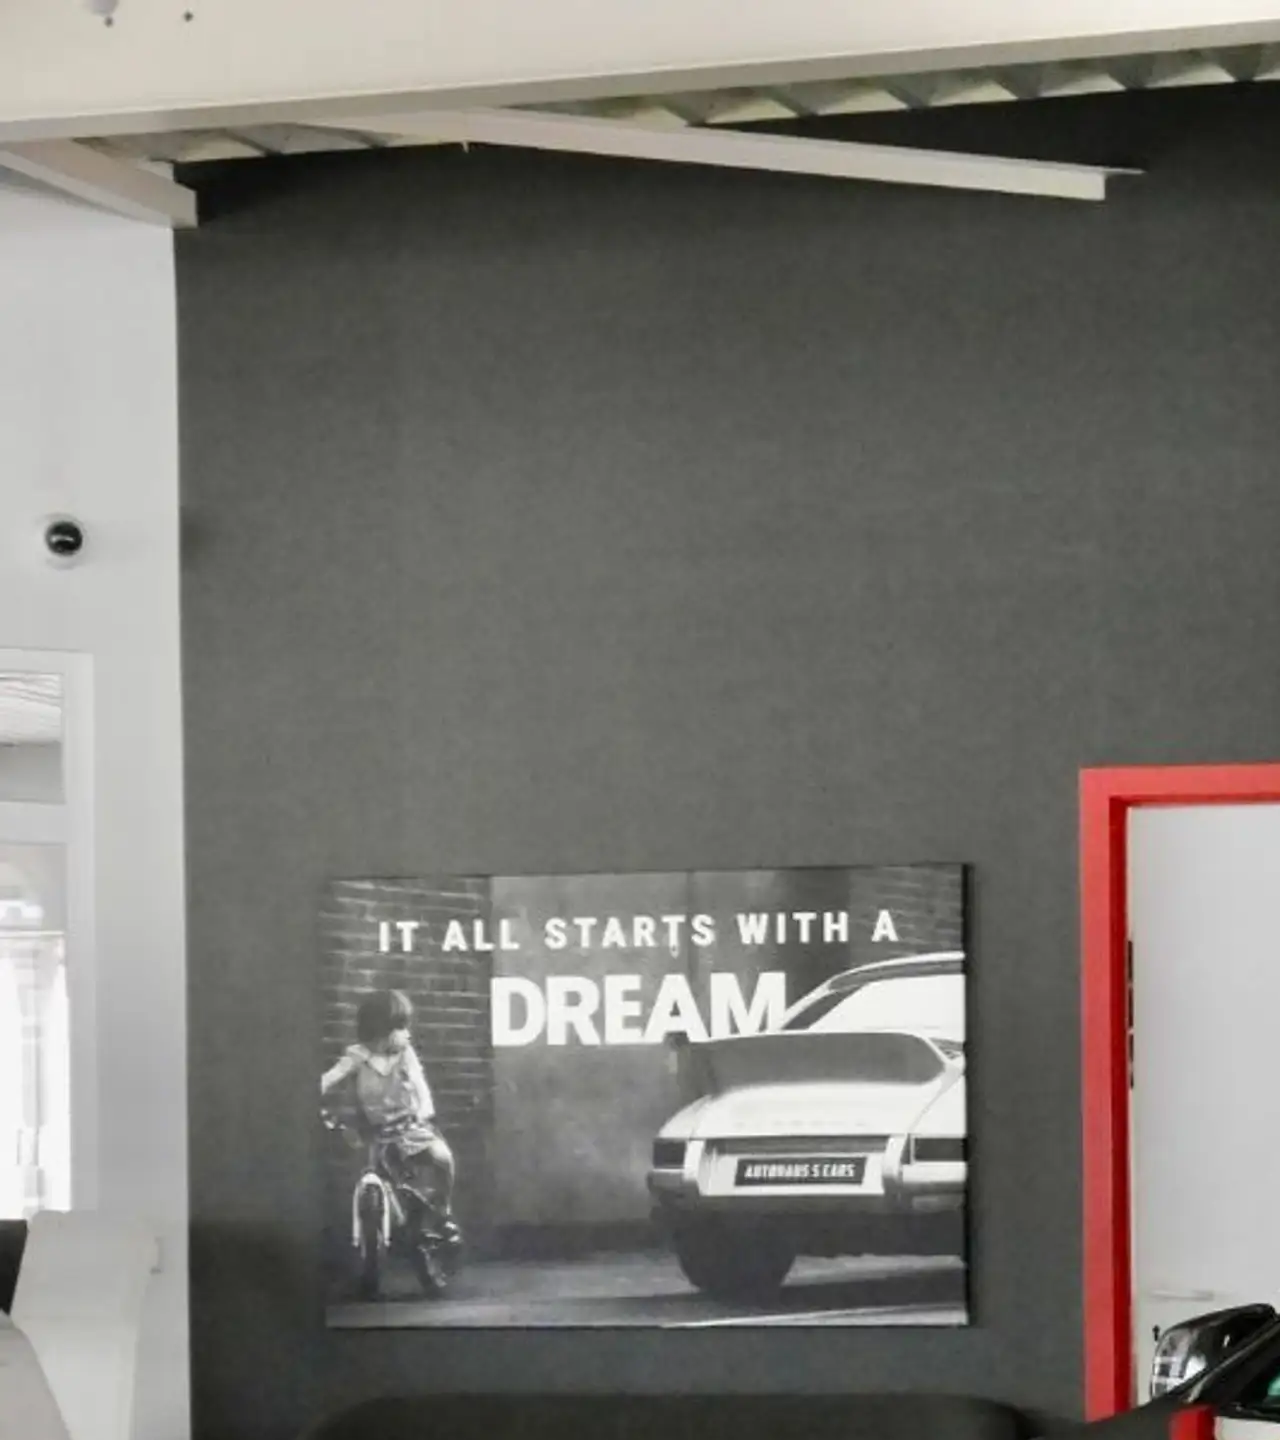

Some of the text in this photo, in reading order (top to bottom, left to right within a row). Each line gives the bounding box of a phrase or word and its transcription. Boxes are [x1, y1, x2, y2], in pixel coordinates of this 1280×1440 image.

[379, 909, 898, 952] IT ALL STARTS WITH A
[490, 971, 786, 1046] DREAM
[743, 1163, 810, 1178] AUTOHAUS
